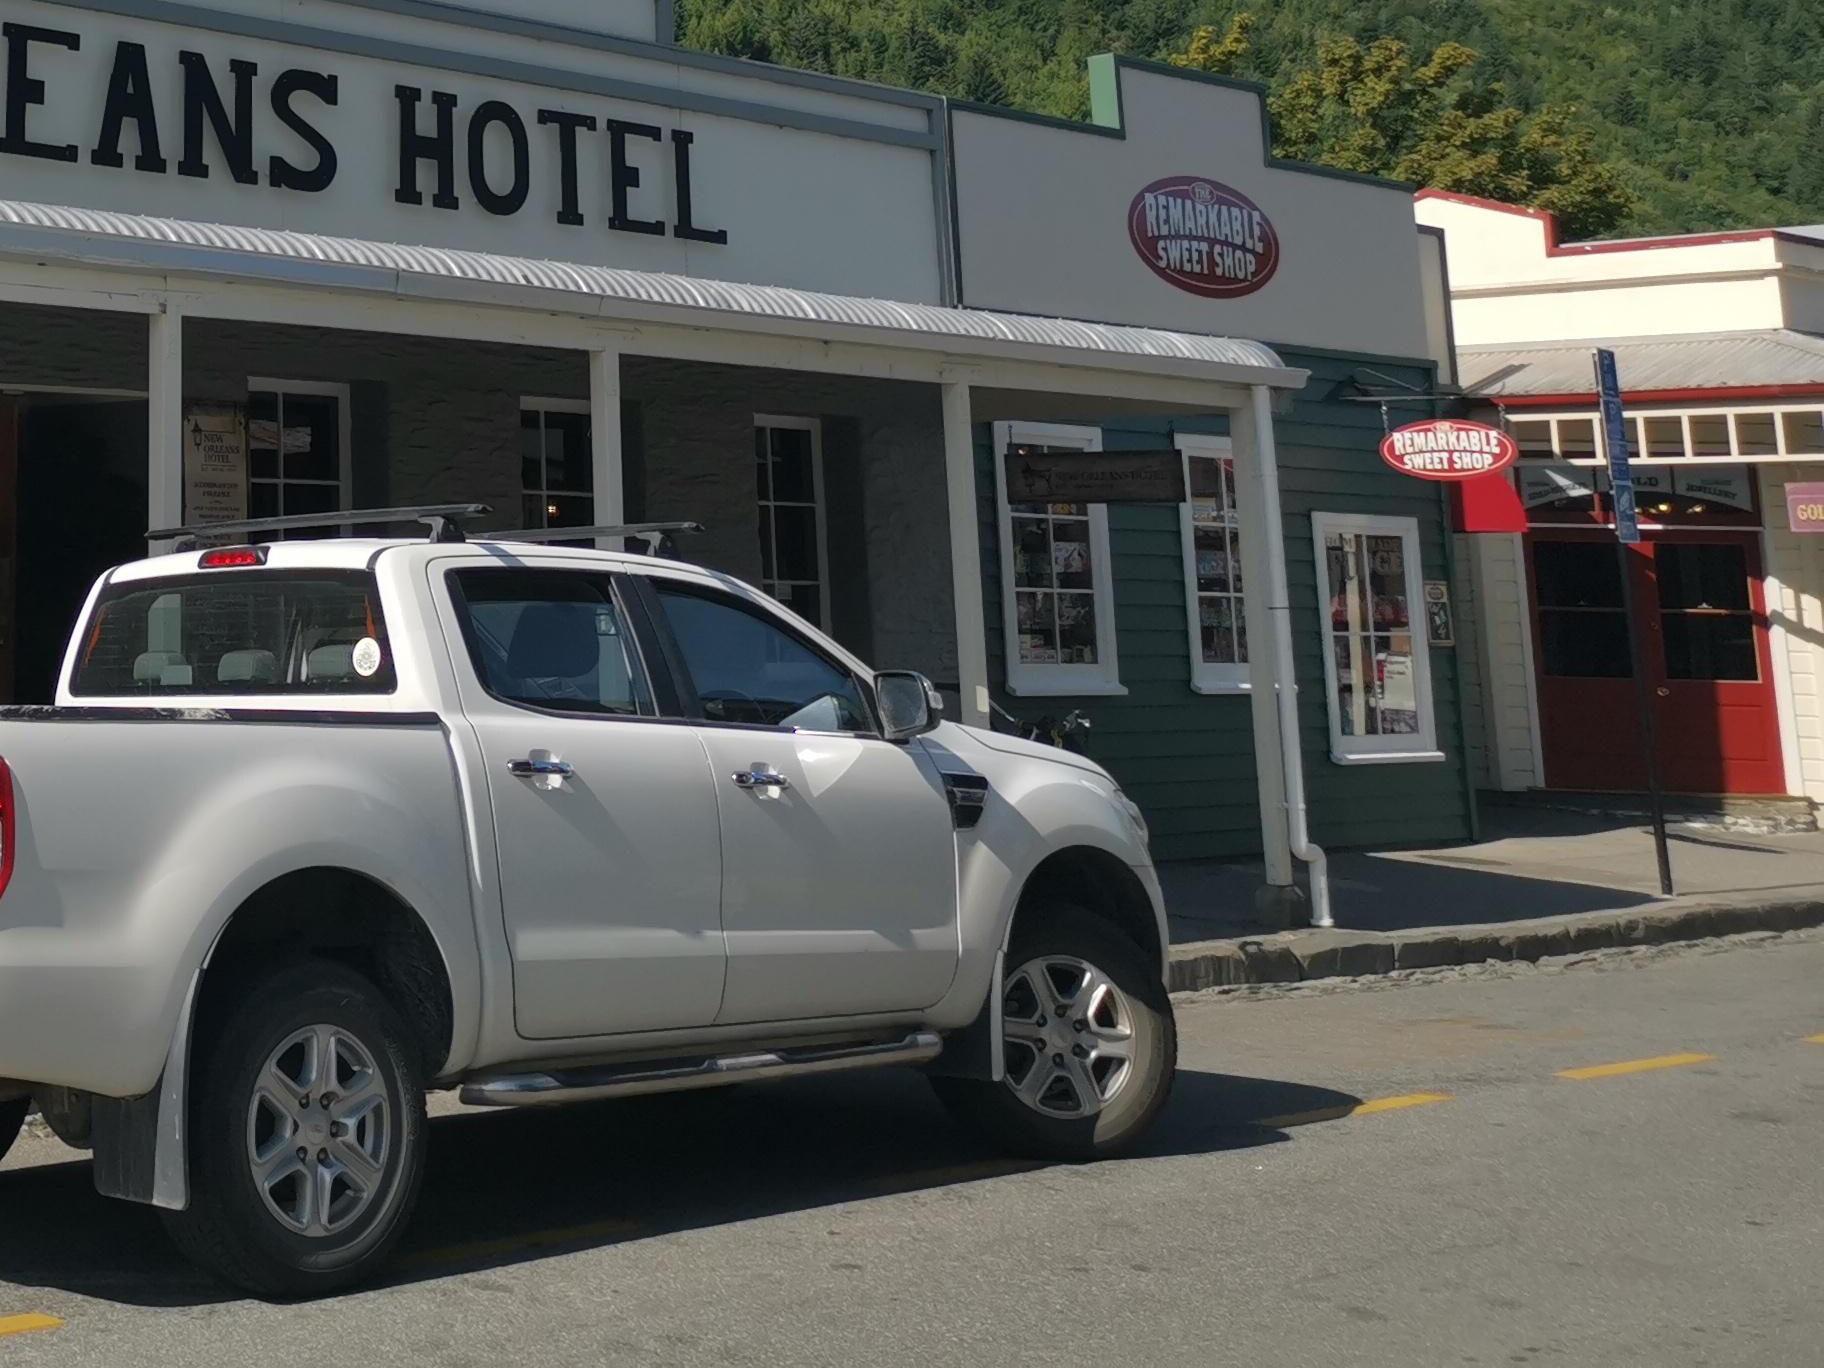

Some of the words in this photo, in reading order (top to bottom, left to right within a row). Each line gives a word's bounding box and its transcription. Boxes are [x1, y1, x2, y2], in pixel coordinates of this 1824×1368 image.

[394, 84, 728, 245] HOTEL
[1144, 192, 1265, 255] REMARKABLE
[1157, 239, 1209, 274] SWEET
[1213, 244, 1256, 281] SHOP
[202, 444, 240, 454] ORLEANS
[203, 433, 224, 443] NEW
[1392, 430, 1501, 456] REMARKABLE
[204, 453, 232, 464] HOTEL
[1403, 452, 1450, 470] SWEET
[1452, 452, 1494, 470] SHOP
